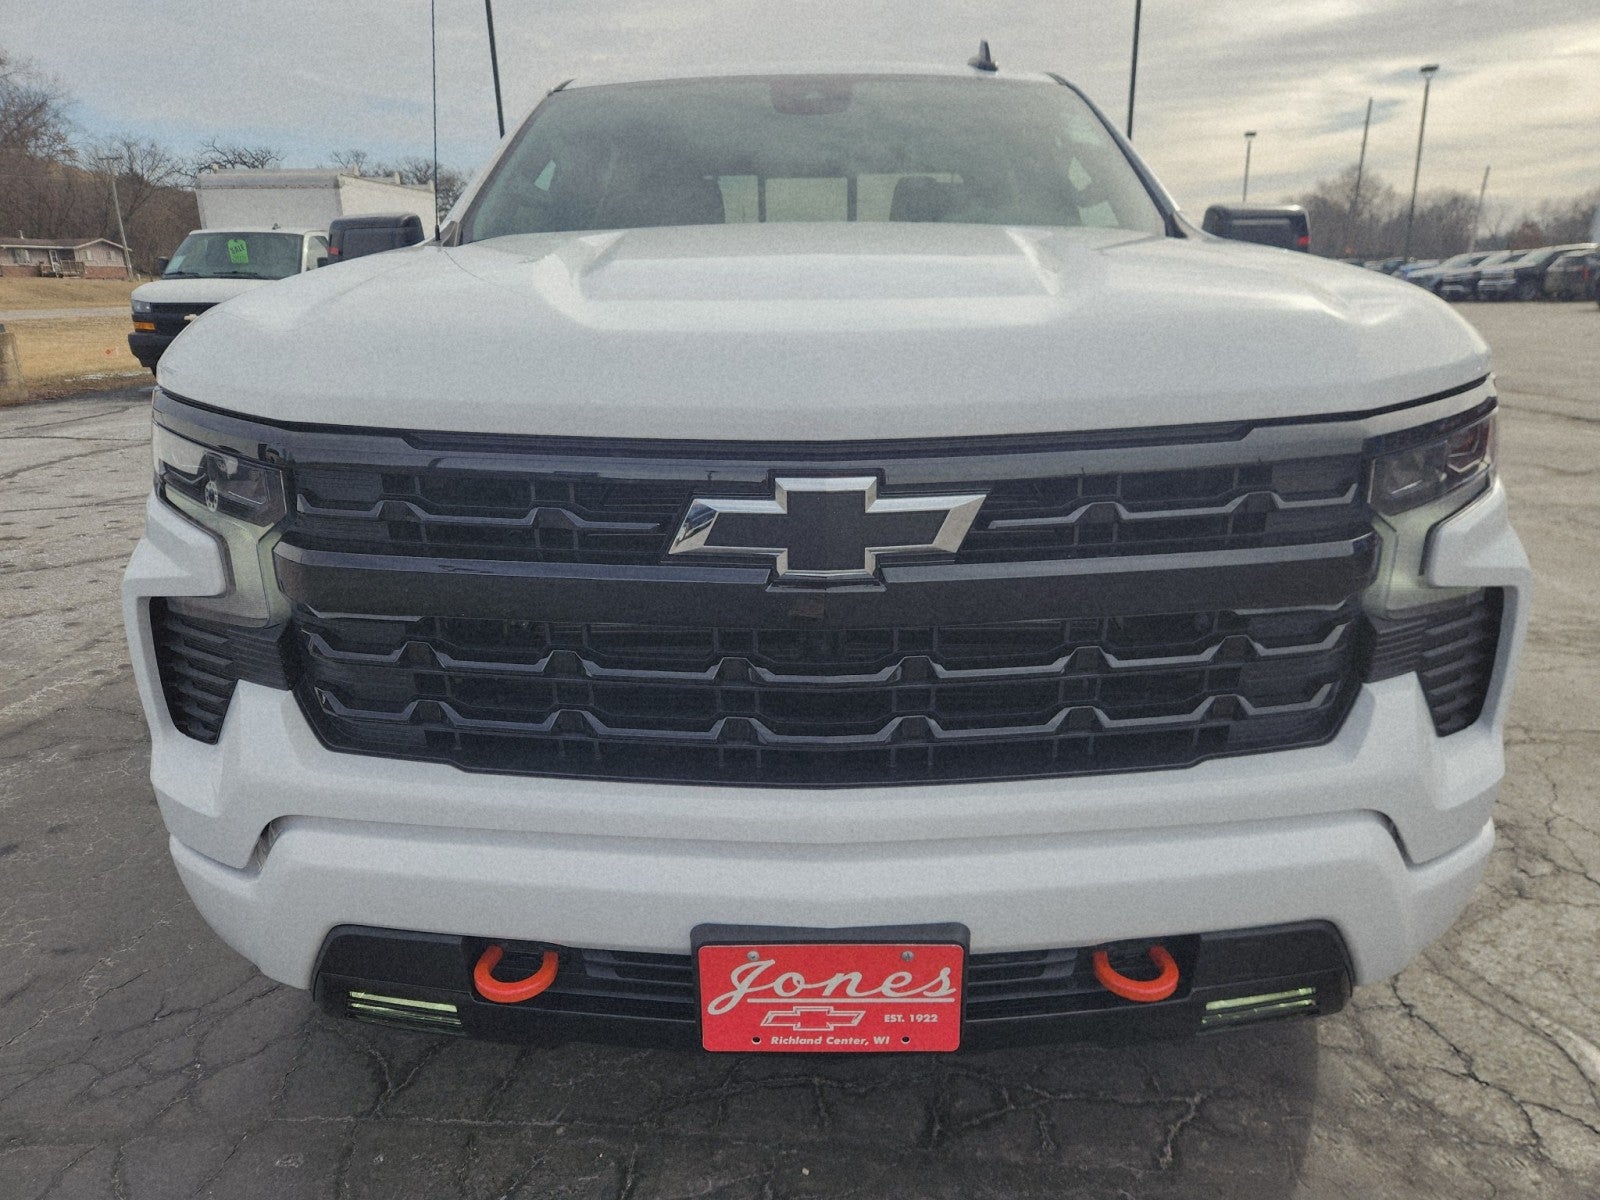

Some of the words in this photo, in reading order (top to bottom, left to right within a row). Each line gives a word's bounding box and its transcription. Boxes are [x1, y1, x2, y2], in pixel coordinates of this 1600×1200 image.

[707, 958, 957, 1015] Jones
[883, 1014, 905, 1023] EST.
[909, 1013, 938, 1023] 1922
[770, 1035, 823, 1045] Richland
[825, 1036, 870, 1047] Center,
[873, 1035, 890, 1045] WI
